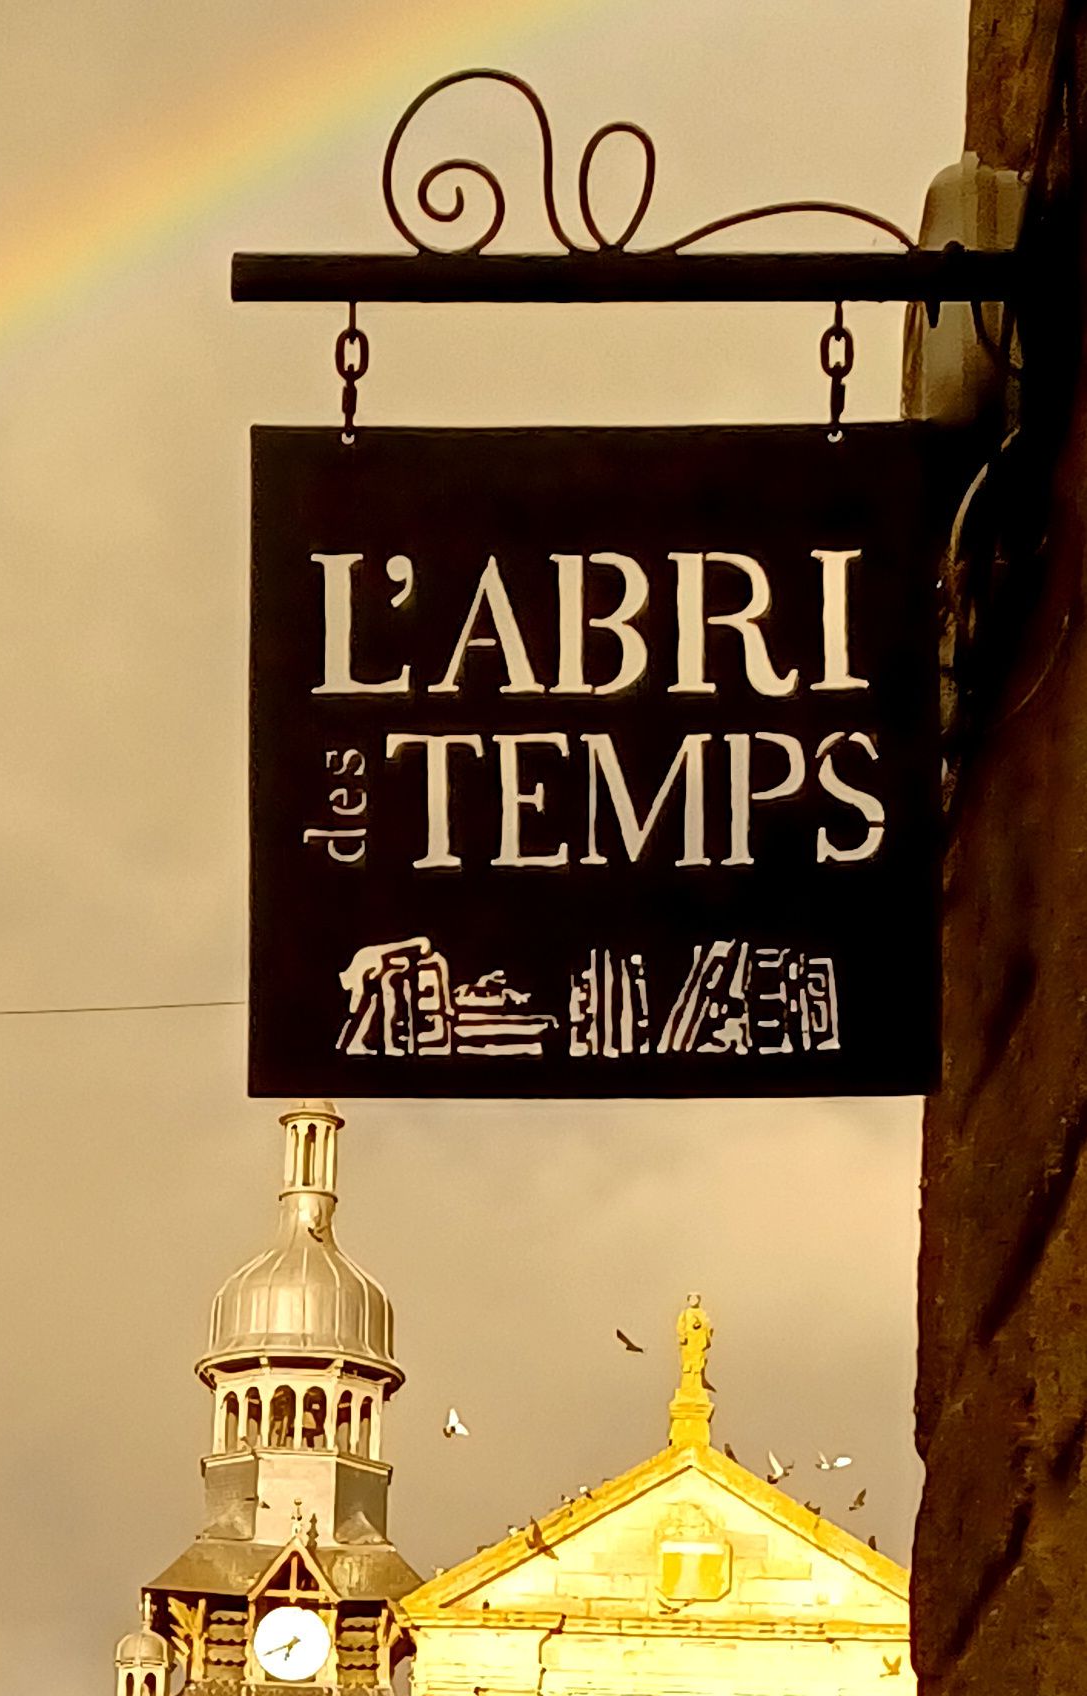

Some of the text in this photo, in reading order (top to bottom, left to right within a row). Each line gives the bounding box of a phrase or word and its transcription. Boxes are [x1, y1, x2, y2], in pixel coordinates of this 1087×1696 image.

[311, 550, 869, 696] L'ABRI
[303, 732, 885, 868] des TEMPS
